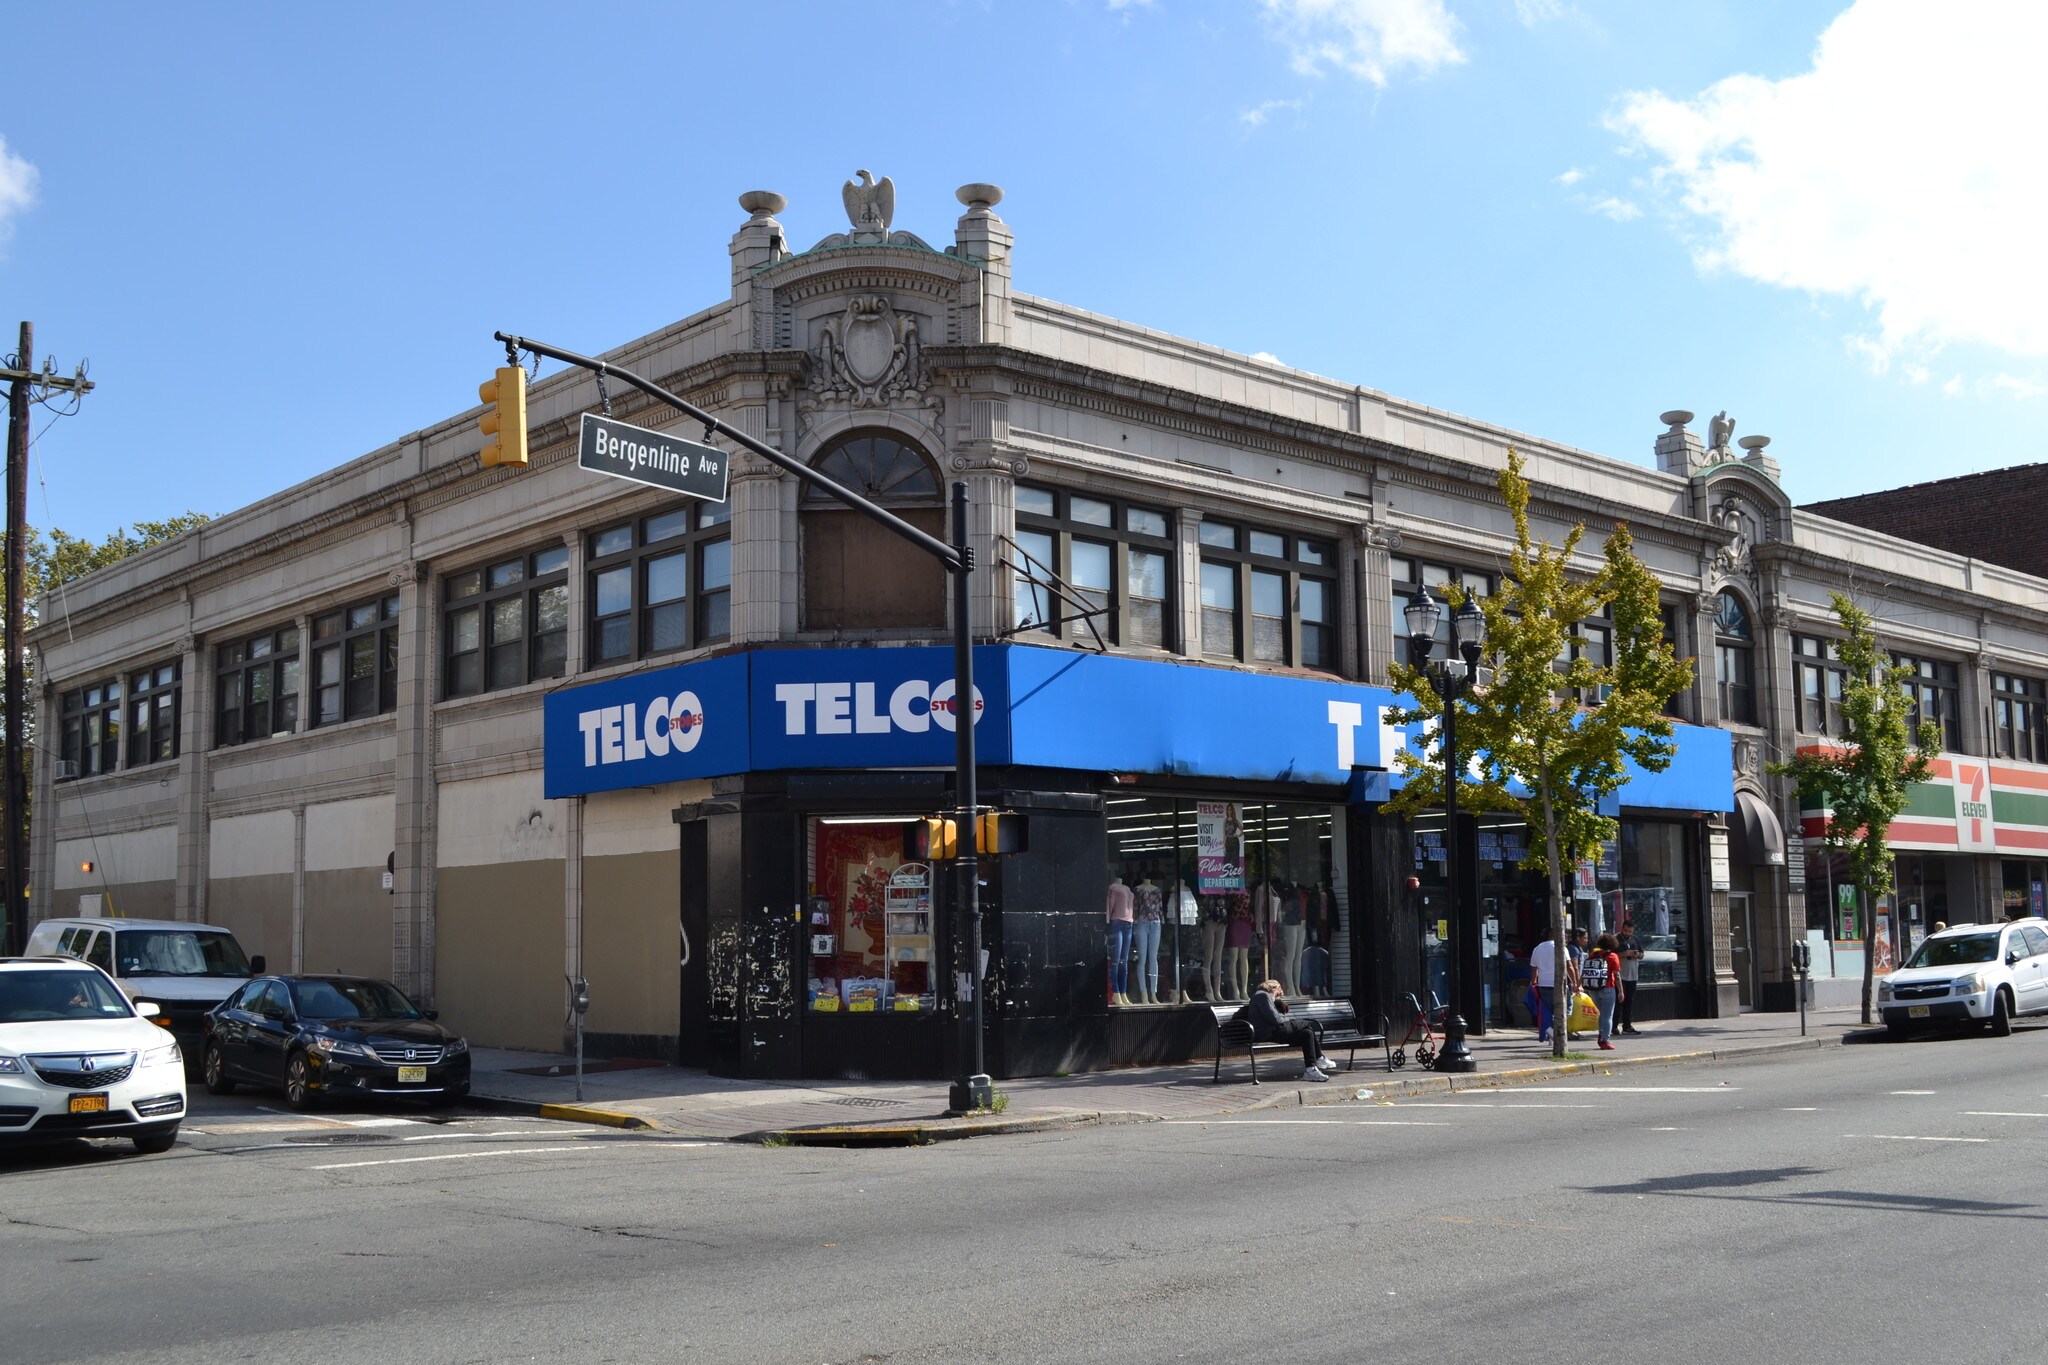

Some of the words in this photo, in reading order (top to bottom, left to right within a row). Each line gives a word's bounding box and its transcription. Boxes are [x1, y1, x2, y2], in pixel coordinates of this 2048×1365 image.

[595, 428, 690, 476] Bergenline
[698, 455, 719, 475] Ave
[775, 678, 985, 736] TELCO
[578, 690, 704, 768] TELCO
[669, 712, 703, 730] STORES
[1198, 804, 1225, 815] TELCO
[1199, 823, 1214, 835] VISIT
[1200, 835, 1211, 847] OUR
[1199, 858, 1222, 874] Plus
[1220, 862, 1244, 878] Size
[1204, 877, 1240, 888] DEPARTMENT
